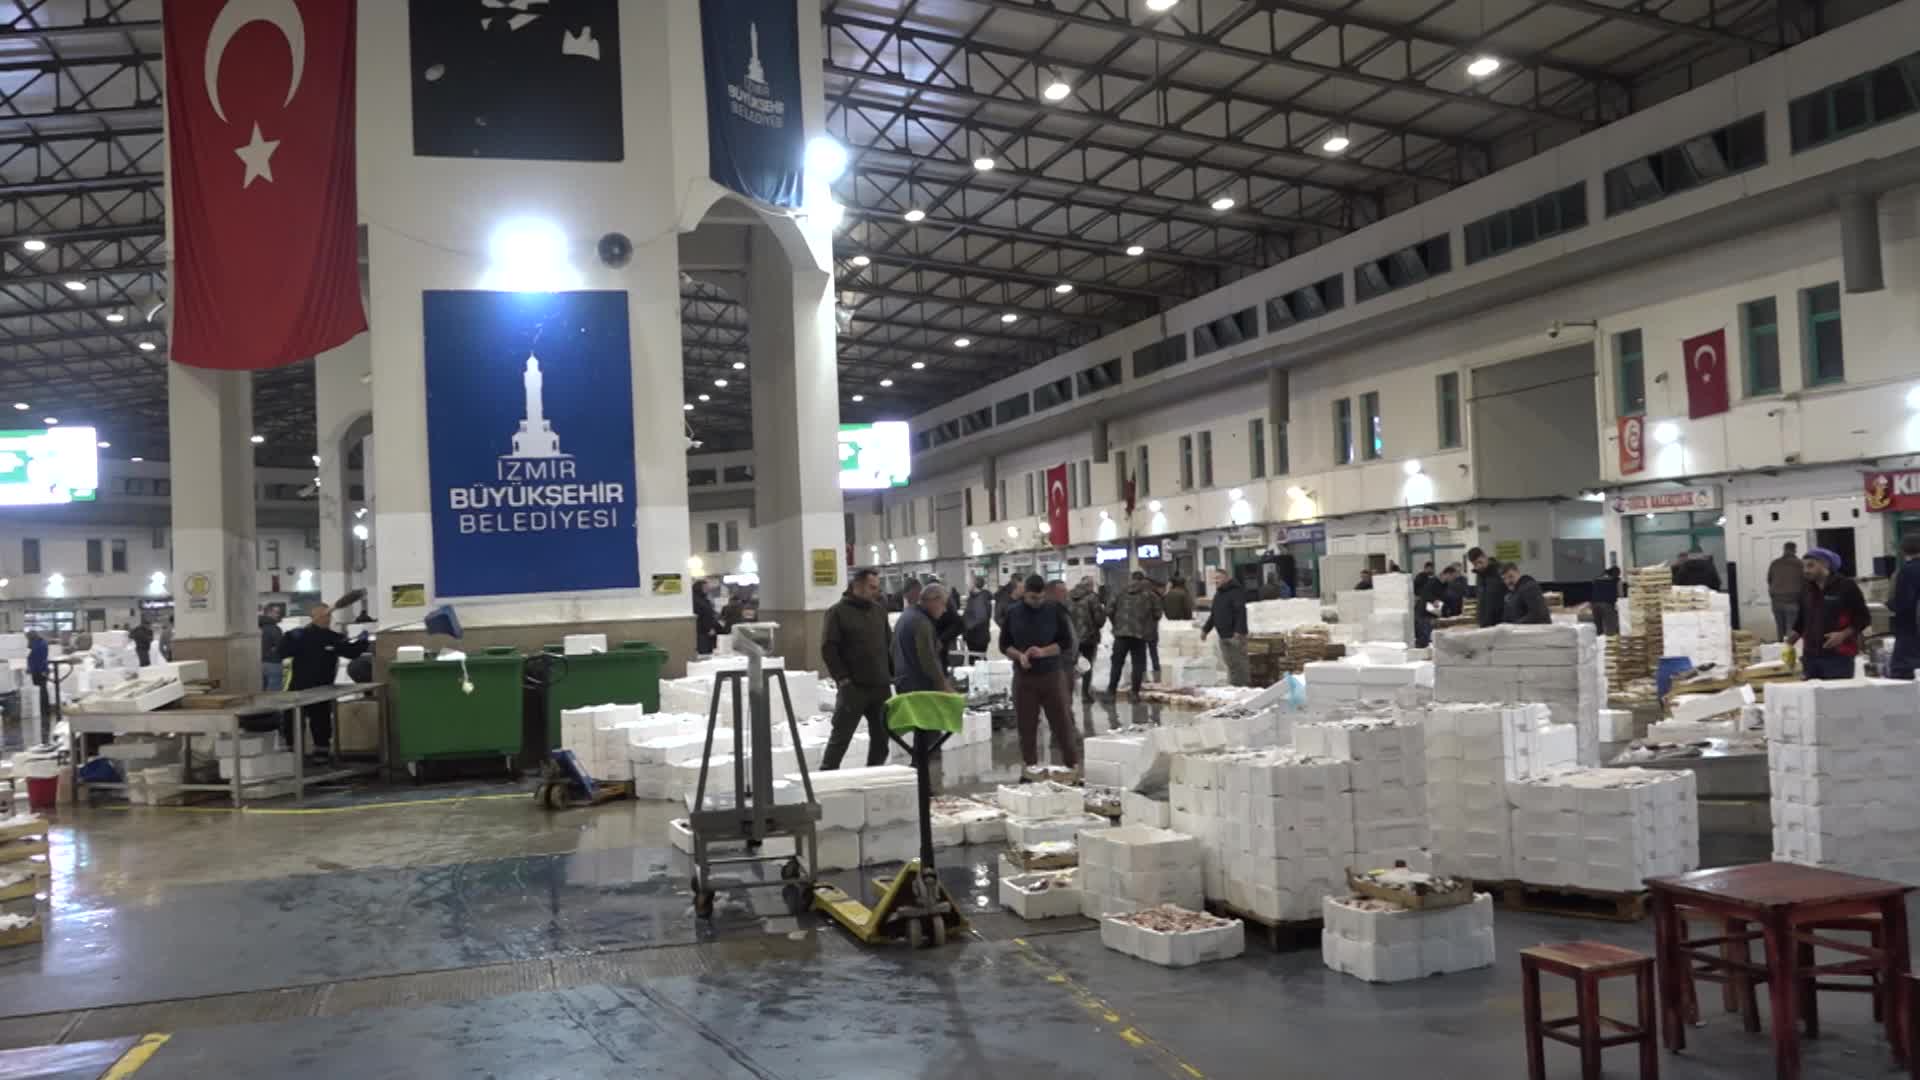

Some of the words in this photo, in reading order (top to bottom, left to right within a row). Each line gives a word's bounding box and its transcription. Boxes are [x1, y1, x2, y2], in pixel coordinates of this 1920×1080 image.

[497, 459, 577, 482] İZMİR
[450, 481, 625, 509] BÜYÜKŞEHİR
[459, 508, 618, 534] BELEDİYESİ
